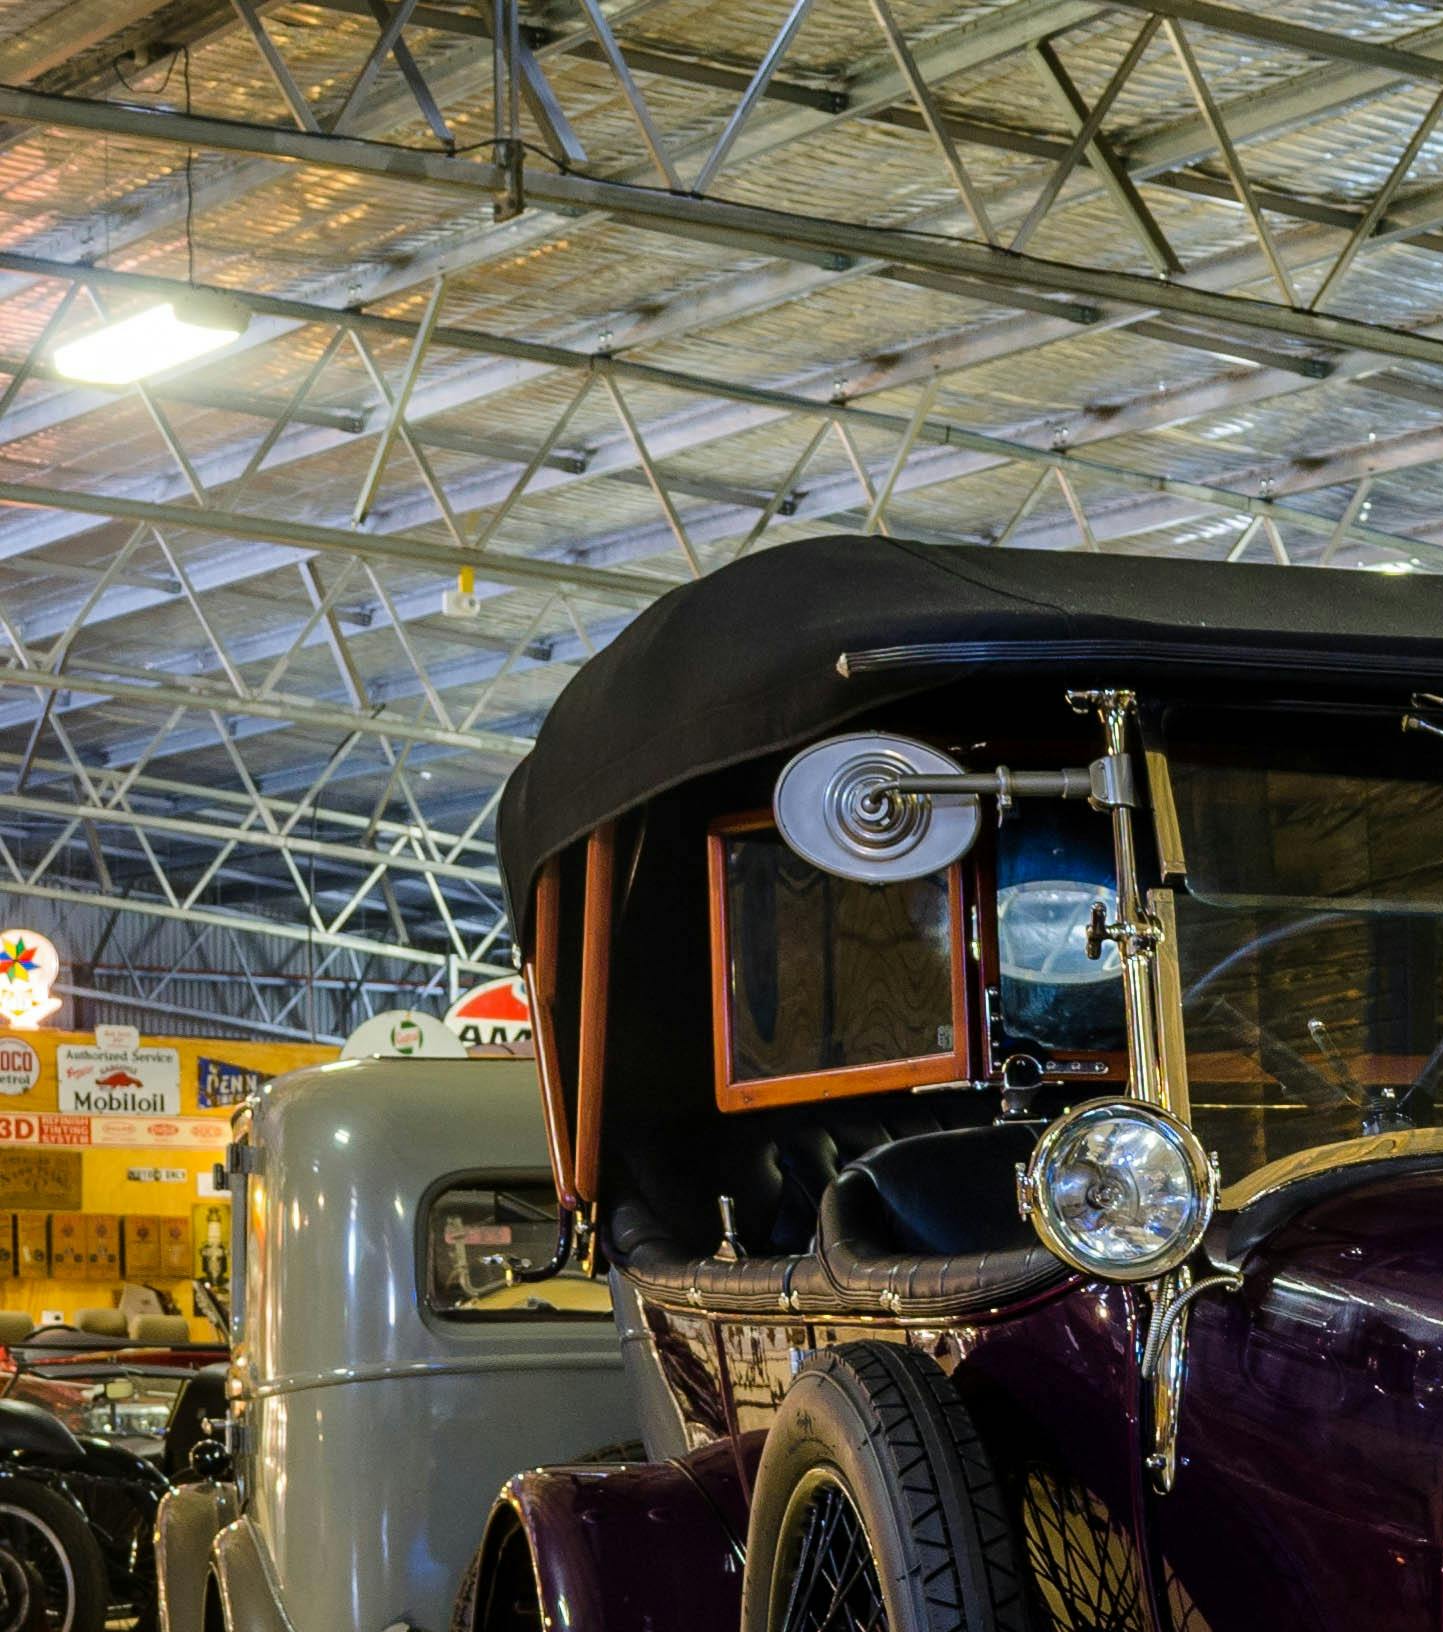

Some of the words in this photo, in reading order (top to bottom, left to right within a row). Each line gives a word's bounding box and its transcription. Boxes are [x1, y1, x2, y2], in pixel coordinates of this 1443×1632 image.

[66, 1050, 128, 1062] Authorized
[131, 1050, 173, 1063] Service
[74, 1091, 165, 1113] Mobiloil
